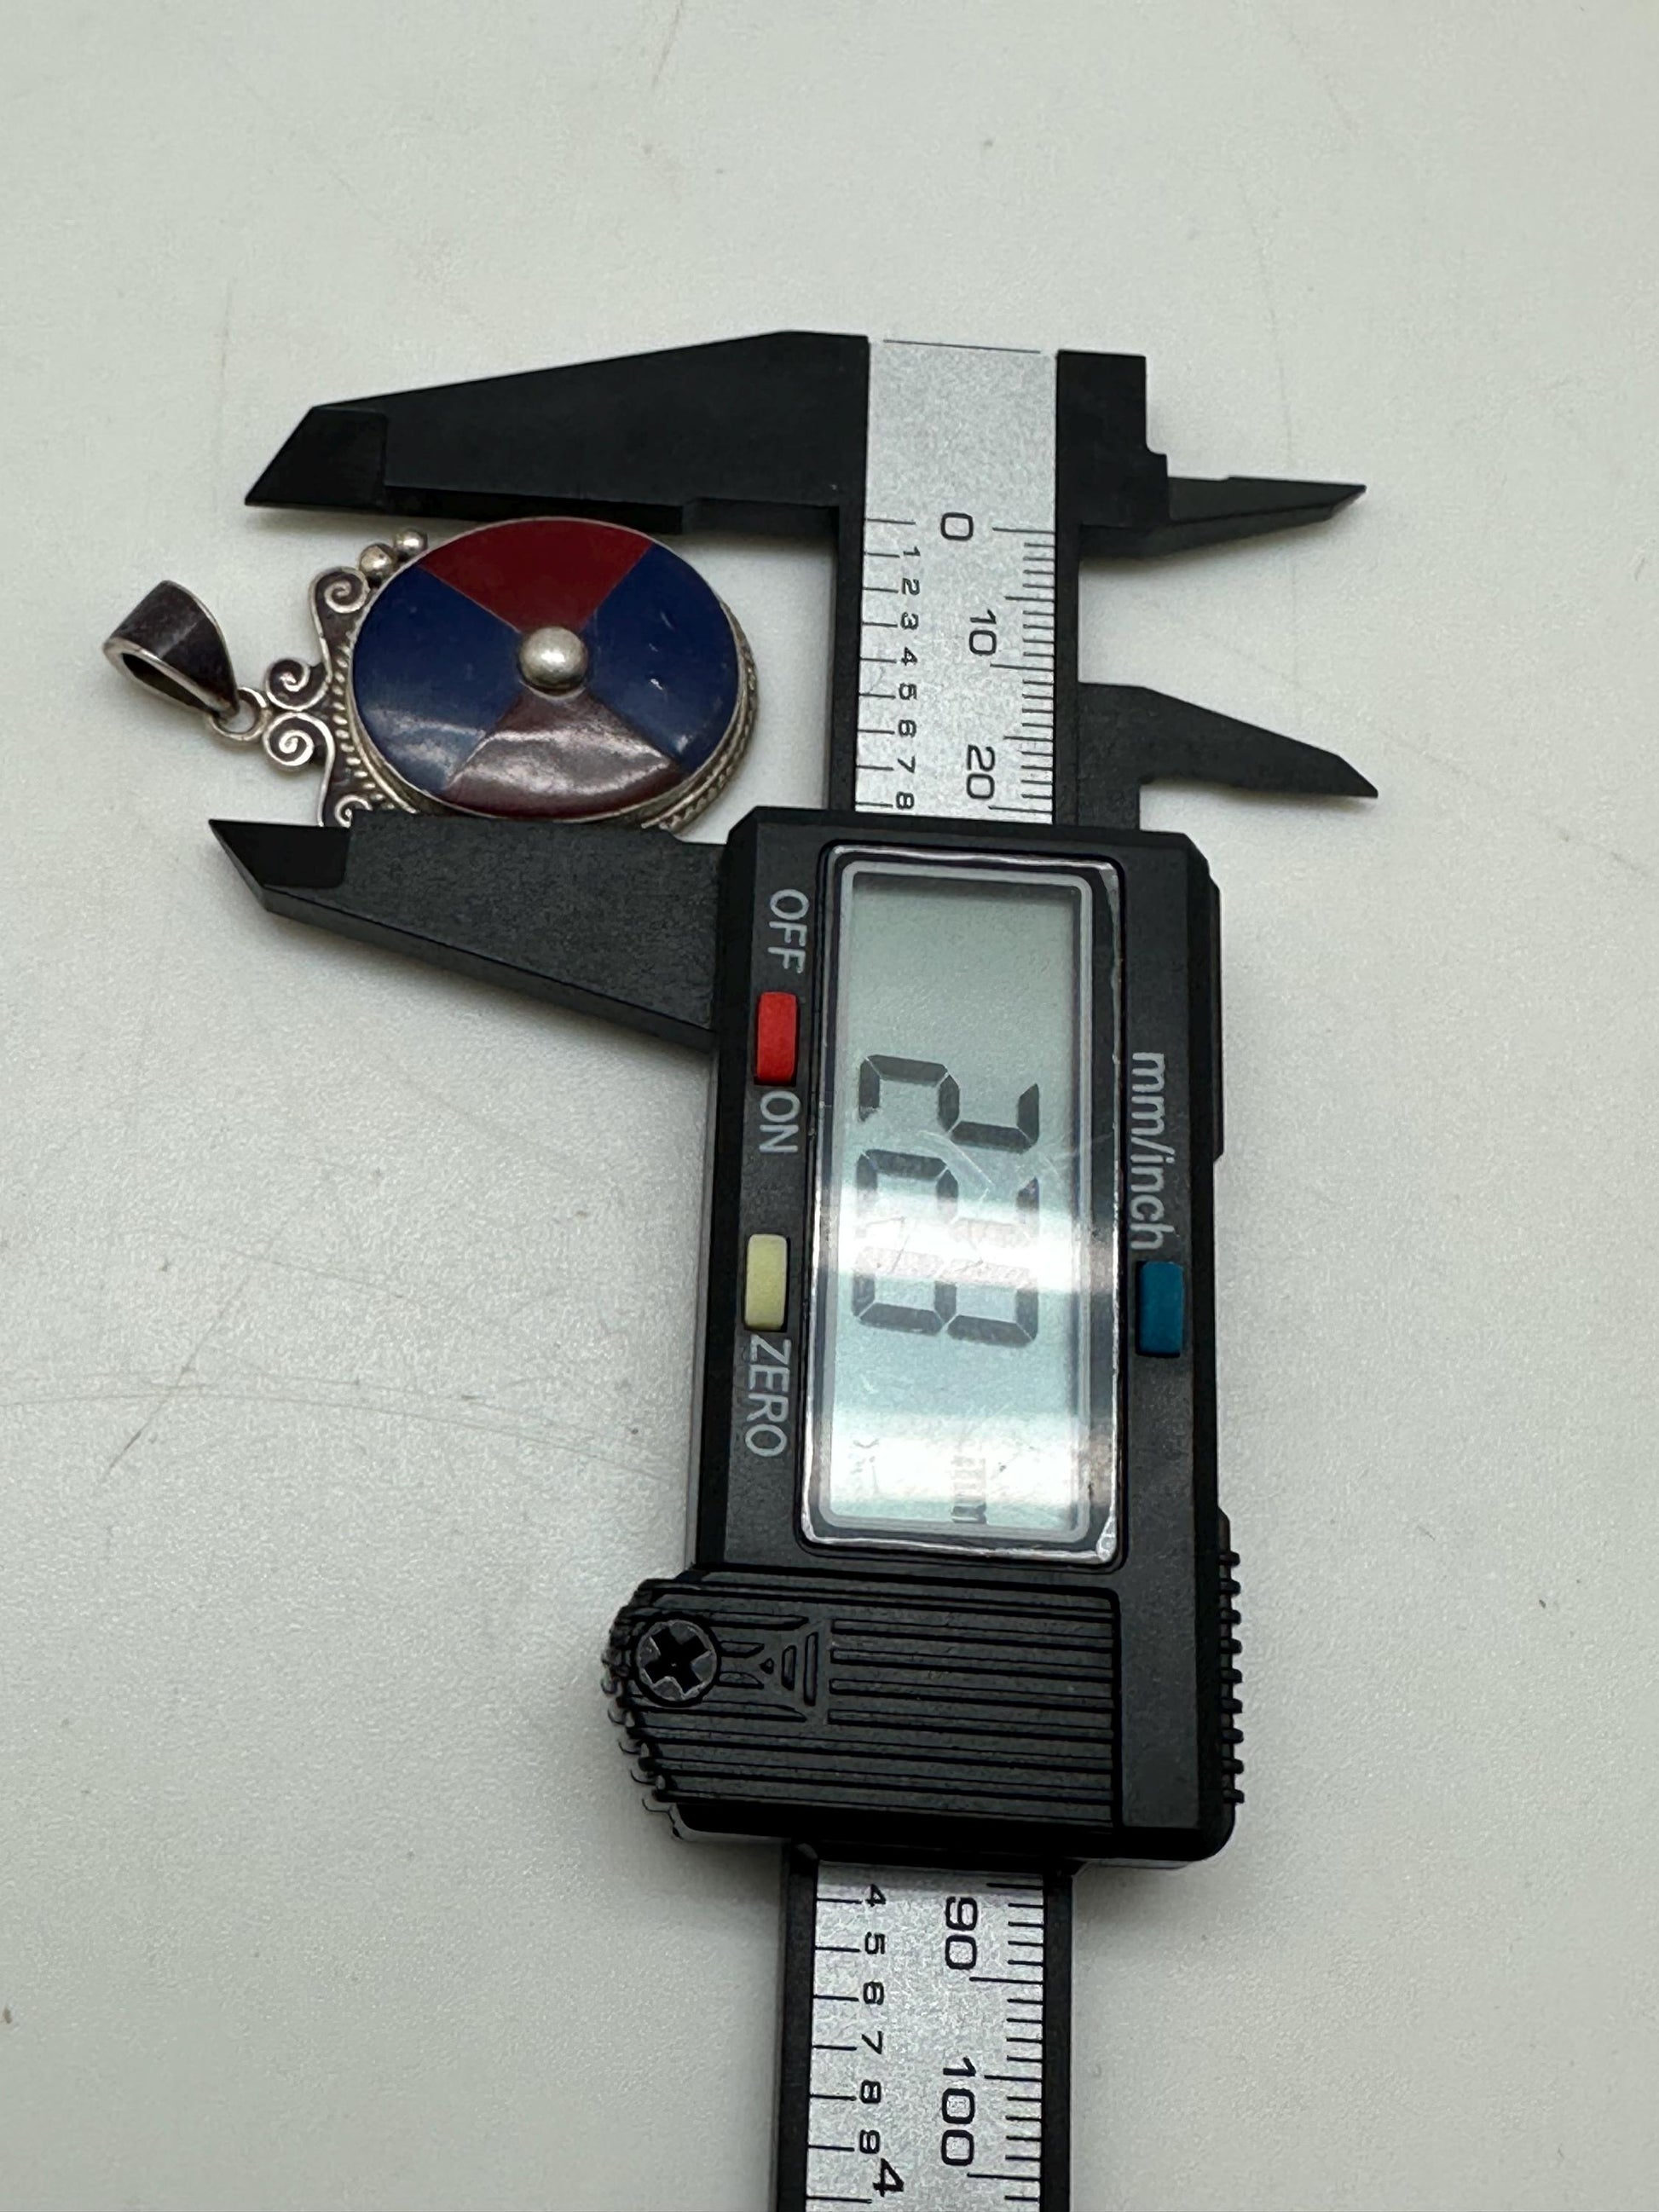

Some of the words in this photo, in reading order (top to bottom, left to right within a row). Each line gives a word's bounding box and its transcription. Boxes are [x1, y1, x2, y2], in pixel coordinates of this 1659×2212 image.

[940, 511, 974, 540] 0
[903, 546, 921, 557] 1
[902, 578, 920, 595] 2
[900, 612, 918, 630] 3
[969, 609, 997, 656] 10
[901, 647, 918, 666] 4
[899, 683, 917, 701] 5
[898, 719, 916, 737] 6
[898, 756, 916, 774] 7
[967, 744, 995, 800] 20
[896, 791, 915, 810] 8
[769, 889, 810, 973] OFF
[759, 1090, 801, 1152] ON
[1130, 1052, 1176, 1250] mm/inch
[745, 1333, 791, 1457] ZERO
[865, 1884, 886, 1908] 4
[864, 1932, 886, 1955] 5
[945, 1896, 978, 1969] 90
[863, 1981, 885, 2006] 6
[861, 2030, 883, 2055] 7
[859, 2080, 882, 2104] 8
[941, 2057, 976, 2166] 100
[859, 2129, 880, 2154] 9
[873, 2157, 905, 2198] 4
